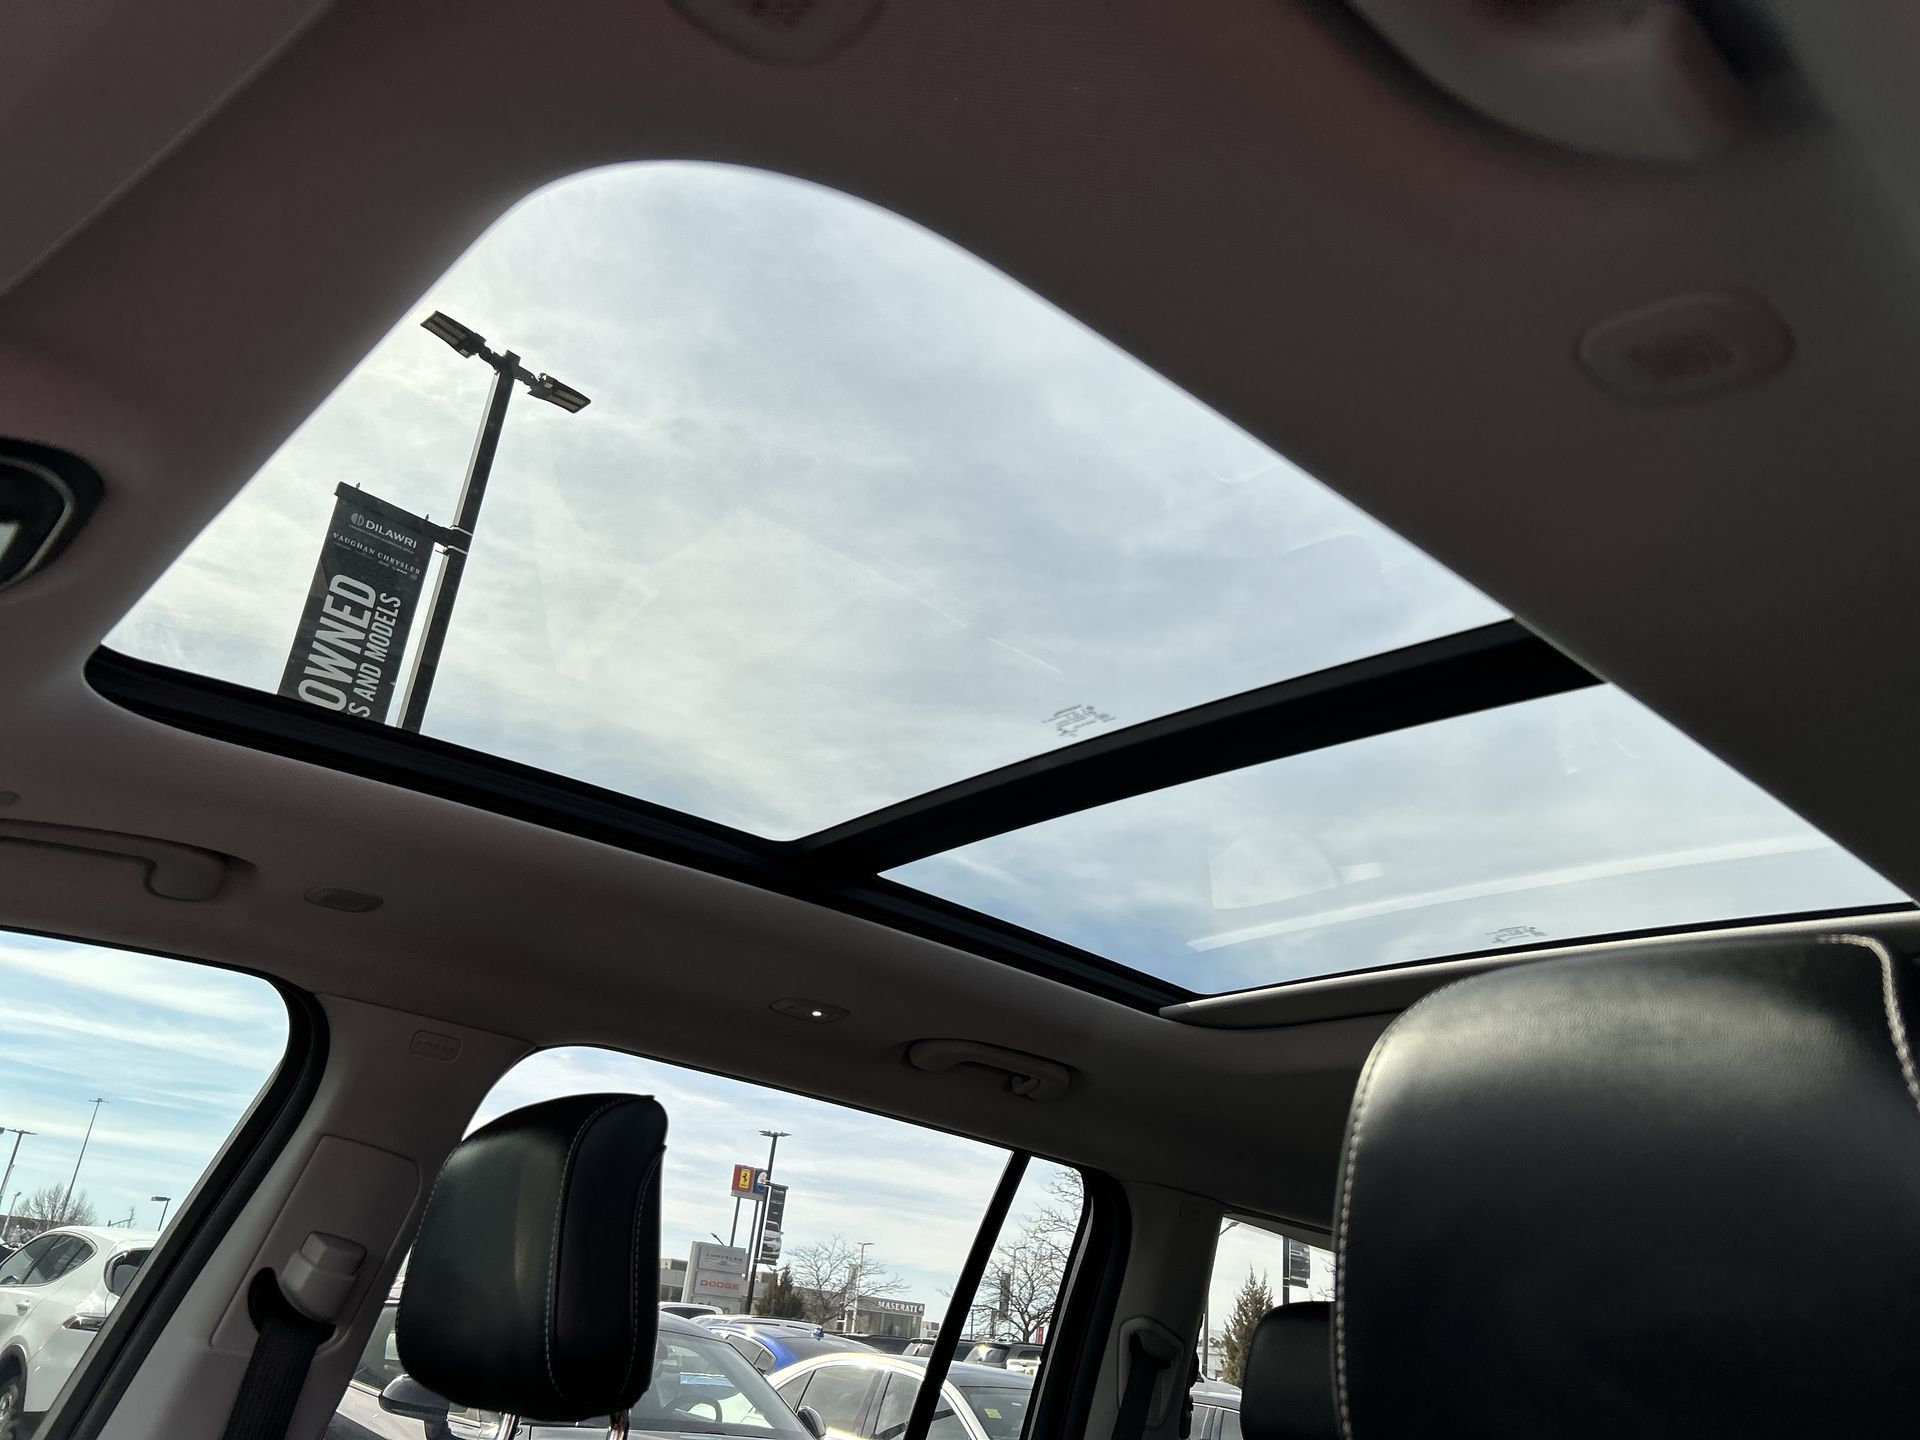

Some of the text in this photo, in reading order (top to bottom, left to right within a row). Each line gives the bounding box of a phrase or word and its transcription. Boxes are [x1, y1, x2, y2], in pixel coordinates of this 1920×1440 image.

[333, 532, 376, 555] VAUGHAN
[377, 552, 421, 575] CHRYSLER
[365, 519, 417, 549] DILAWRI
[298, 574, 377, 711] OWNED
[364, 592, 402, 663] MODELS
[353, 662, 382, 702] AND
[700, 1279, 740, 1291] DODGE
[877, 1300, 918, 1313] MASERATI
